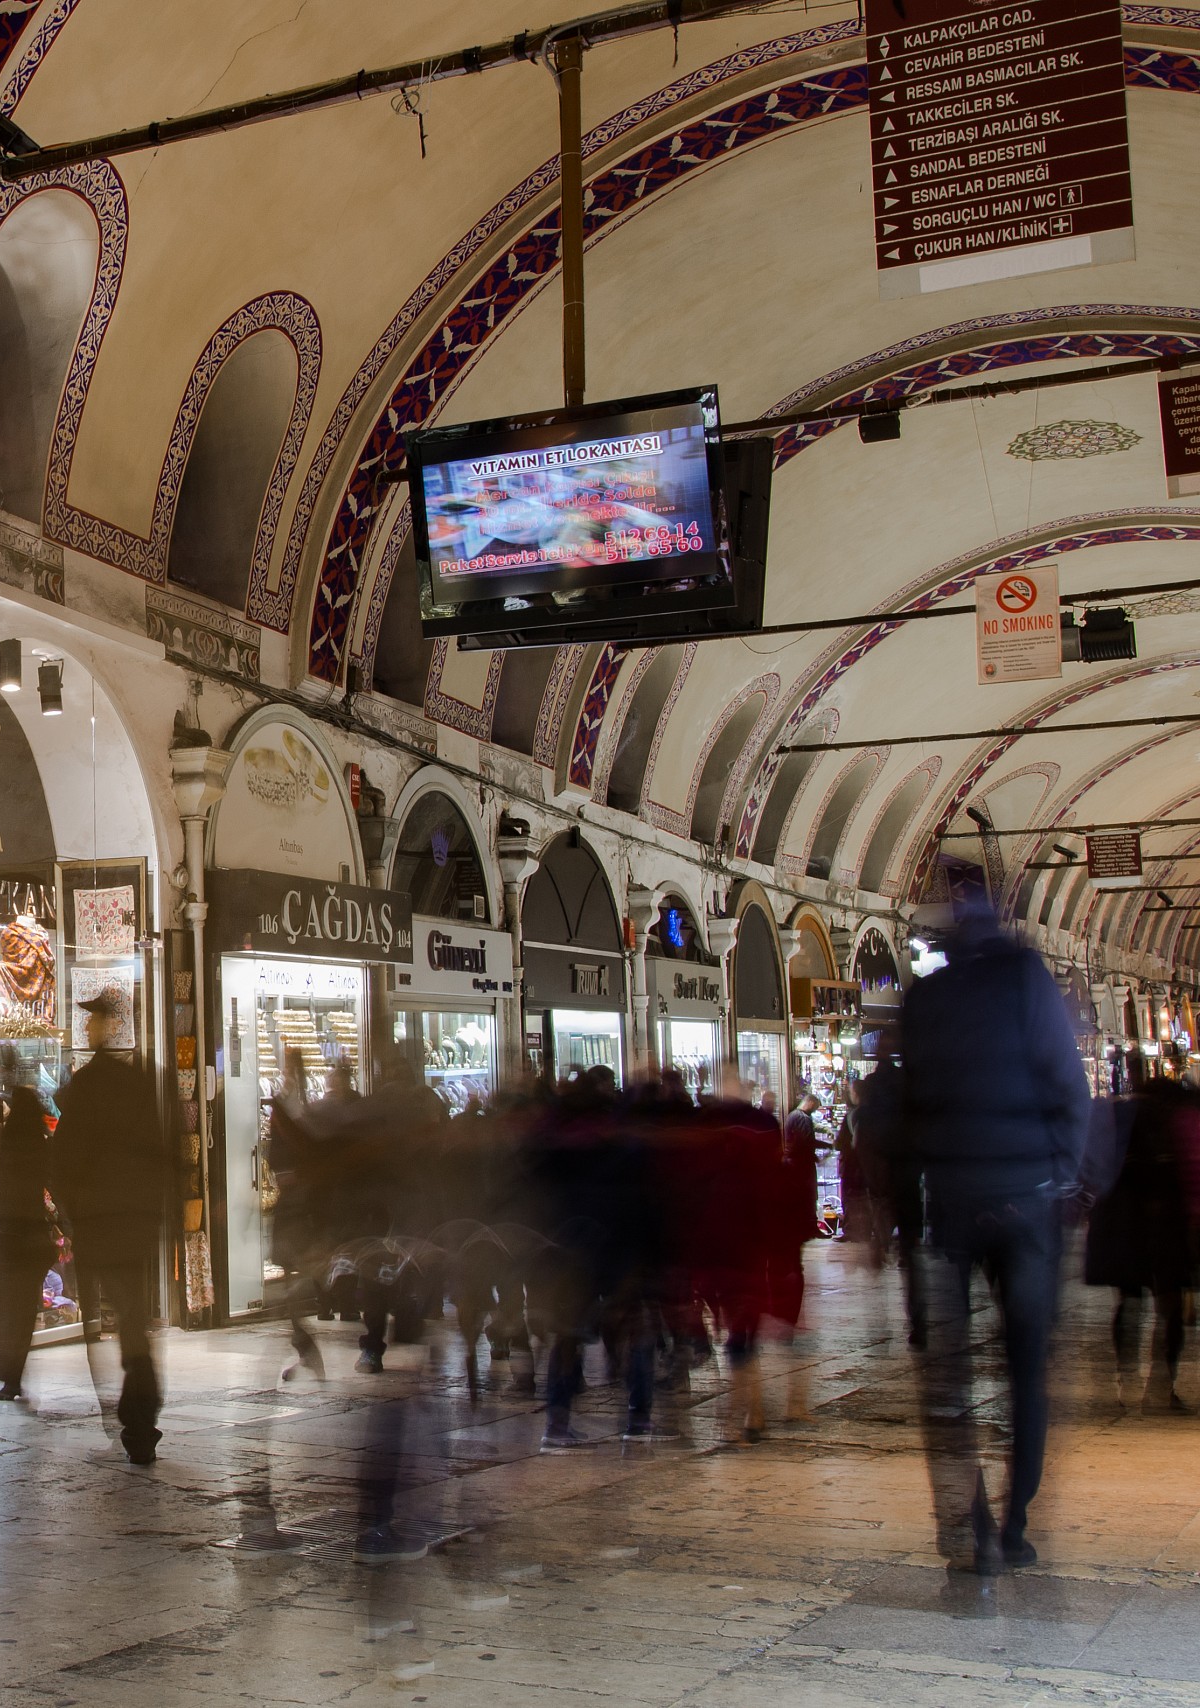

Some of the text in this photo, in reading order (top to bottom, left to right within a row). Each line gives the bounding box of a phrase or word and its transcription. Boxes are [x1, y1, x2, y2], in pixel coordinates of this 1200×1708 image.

[903, 9, 1036, 49] KALPAKÇILAR CAD.
[904, 29, 1045, 74] CEVAHİR BEDESTENİ
[905, 51, 1084, 101] RESSAM BASMACILAR SK.
[907, 91, 1019, 127] TAKKECİLER SK.
[908, 109, 1065, 153] TERZİBAŞI ARALIĞI SK.
[909, 136, 1047, 179] SANDAL BEDESTENİ
[911, 163, 1050, 205] ESNAFLAR DERNEĞİ
[912, 203, 989, 231] SORGUÇLU
[992, 197, 1022, 216] HAN
[1033, 191, 1057, 209] WC
[913, 232, 962, 259] ÇUKUR
[545, 449, 565, 467] ET
[567, 436, 662, 462] LOKANTASI
[604, 486, 656, 502] Solda
[983, 614, 1054, 635] NO SMOKING
[258, 884, 412, 954] 106 ÇAĞDAŞ 104
